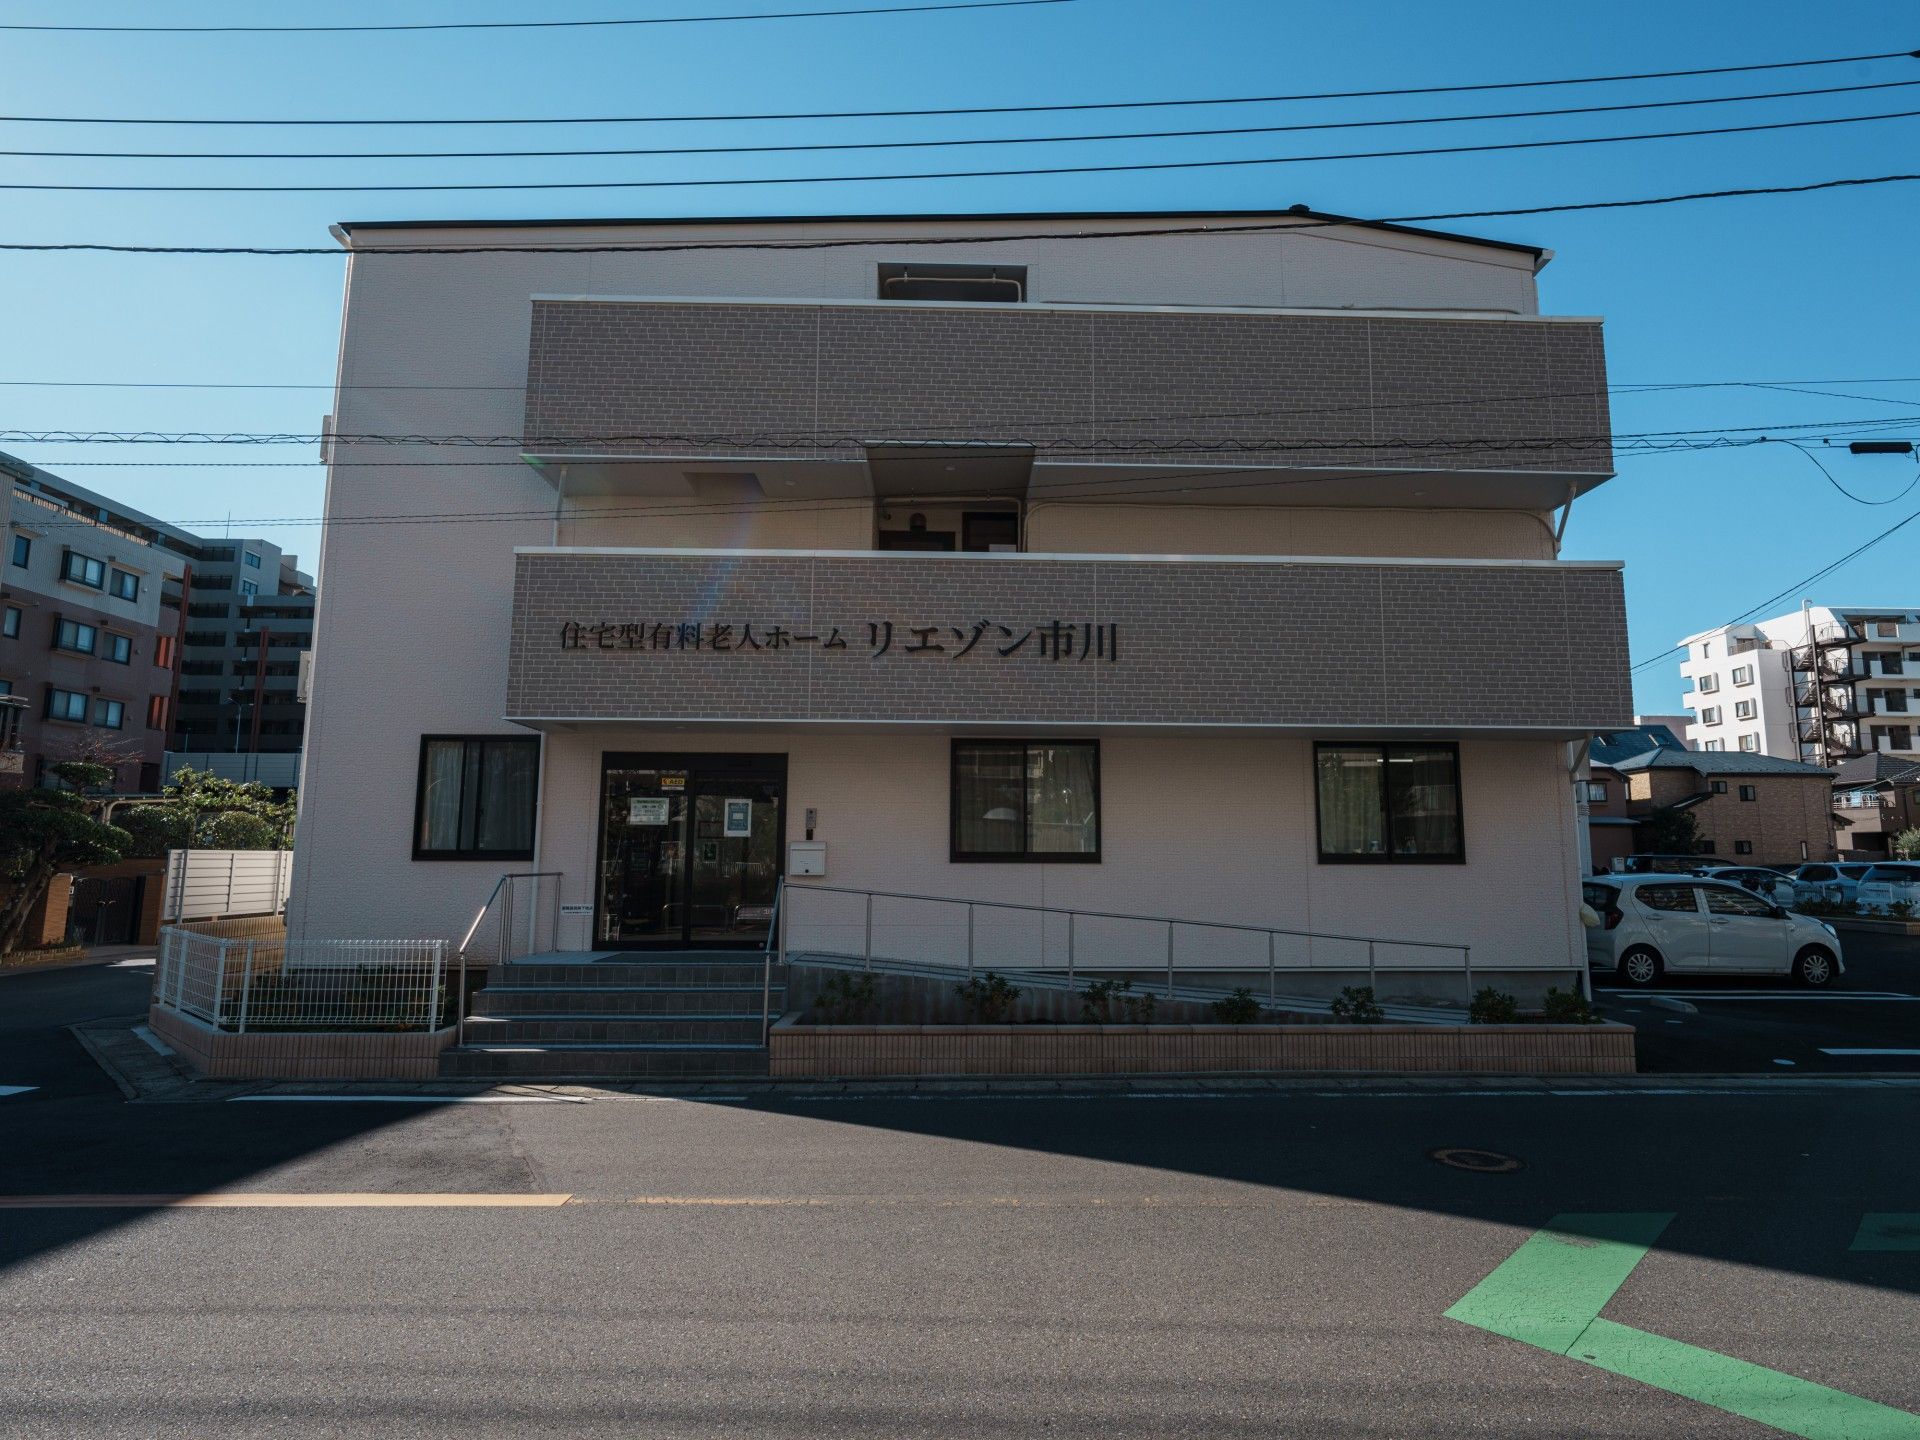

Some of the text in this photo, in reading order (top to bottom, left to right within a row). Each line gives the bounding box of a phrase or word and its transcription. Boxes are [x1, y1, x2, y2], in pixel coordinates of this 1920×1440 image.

[560, 619, 1118, 662] 住宅型有料老人ホーム リエゾン市川
